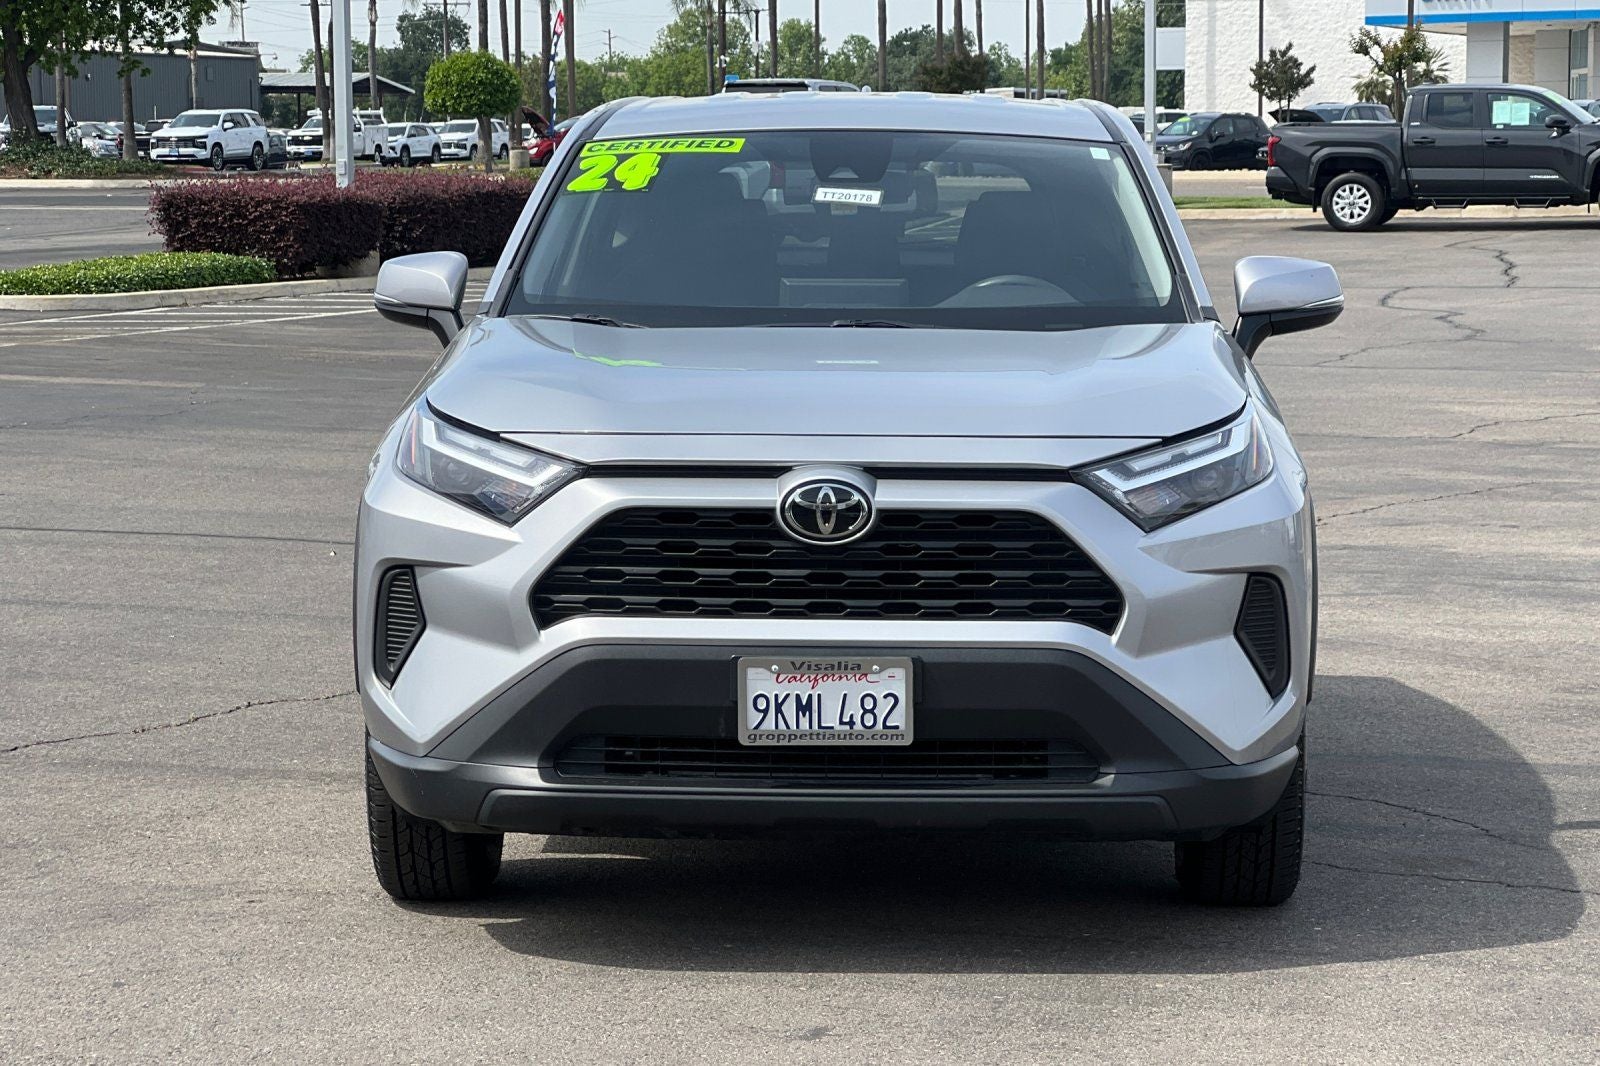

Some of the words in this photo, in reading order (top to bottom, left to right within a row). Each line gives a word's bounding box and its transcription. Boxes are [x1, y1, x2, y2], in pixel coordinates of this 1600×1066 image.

[587, 139, 736, 153] CERTIFIED
[566, 152, 662, 192] 24
[822, 191, 873, 202] TT20178
[790, 661, 862, 672] Visalia
[775, 673, 880, 690] California
[752, 693, 900, 730] 9KML482
[747, 731, 905, 744] groppettiauto.com
